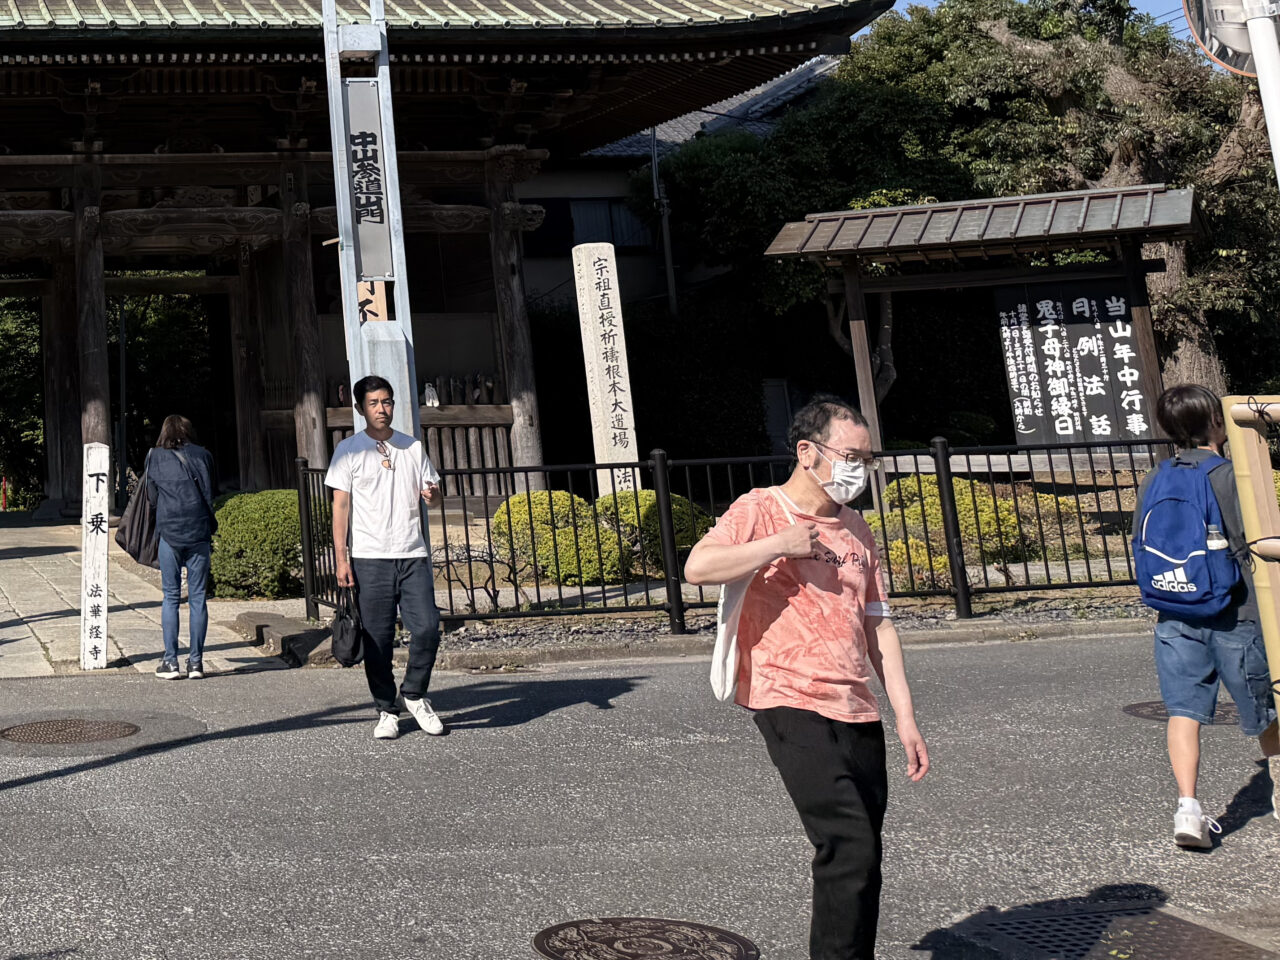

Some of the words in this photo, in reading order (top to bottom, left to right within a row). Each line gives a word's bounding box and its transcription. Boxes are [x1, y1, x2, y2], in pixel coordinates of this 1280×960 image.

[1036, 299, 1074, 435] 鬼子母神御縁日
[1072, 297, 1112, 436] 月例法話
[1105, 295, 1149, 436] 当山年中行事
[86, 583, 103, 661] 法華経寺
[1151, 579, 1197, 593] adidas
